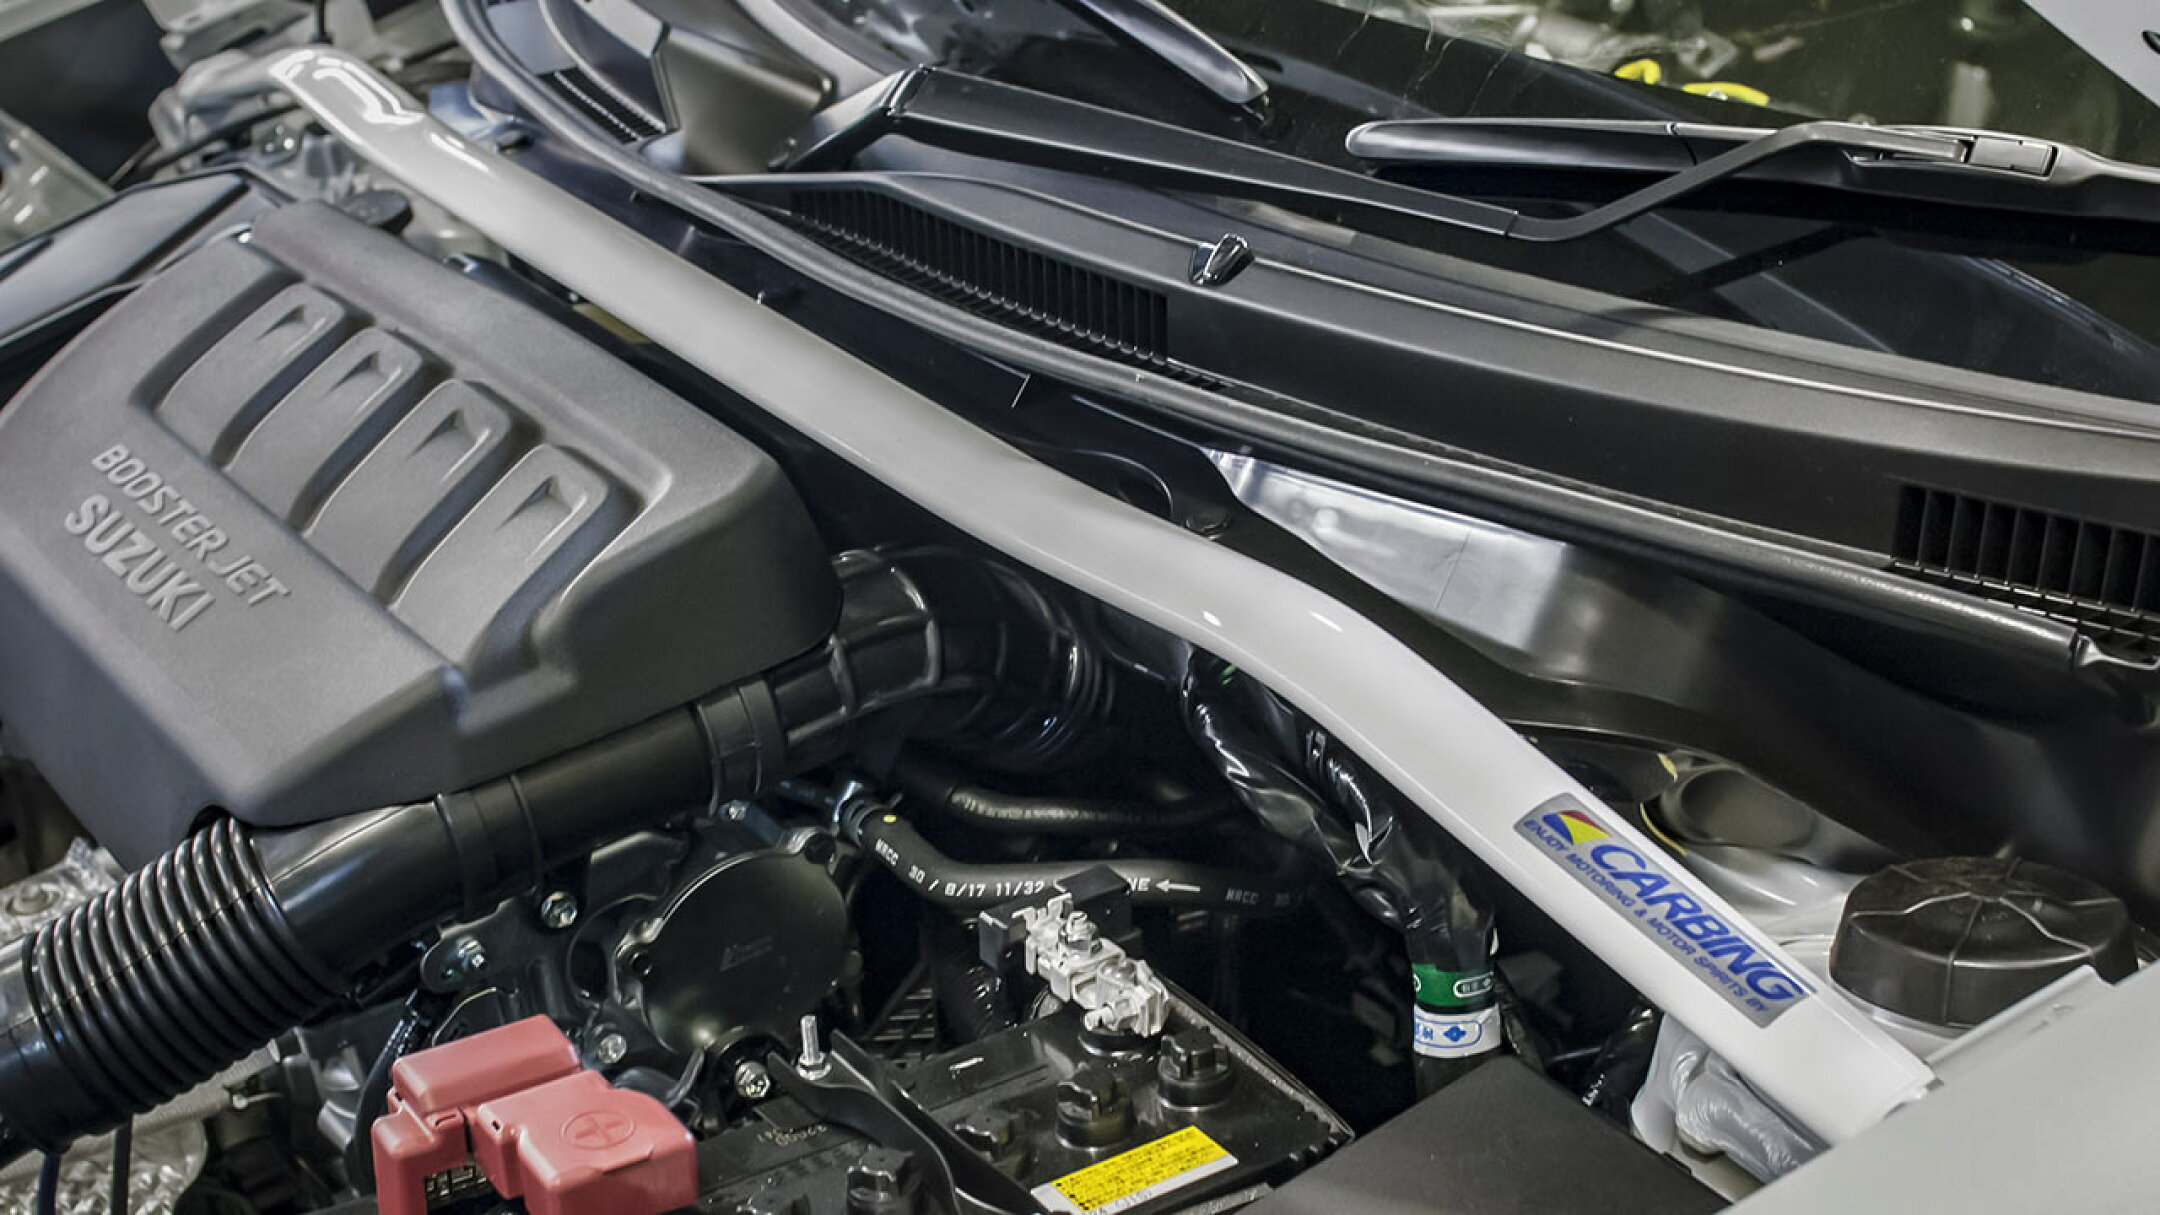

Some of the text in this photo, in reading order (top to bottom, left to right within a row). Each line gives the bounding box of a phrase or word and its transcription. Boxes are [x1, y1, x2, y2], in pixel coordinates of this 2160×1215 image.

[65, 494, 216, 632] SUZUKI
[91, 444, 292, 608] BOOSTER JET
[1523, 820, 1567, 852] ENJOY
[1566, 853, 1636, 908] MOTORING
[1647, 918, 1697, 955] MOTOR
[1694, 957, 1748, 997] SPIRITS
[1590, 845, 1805, 1000] CARBING
